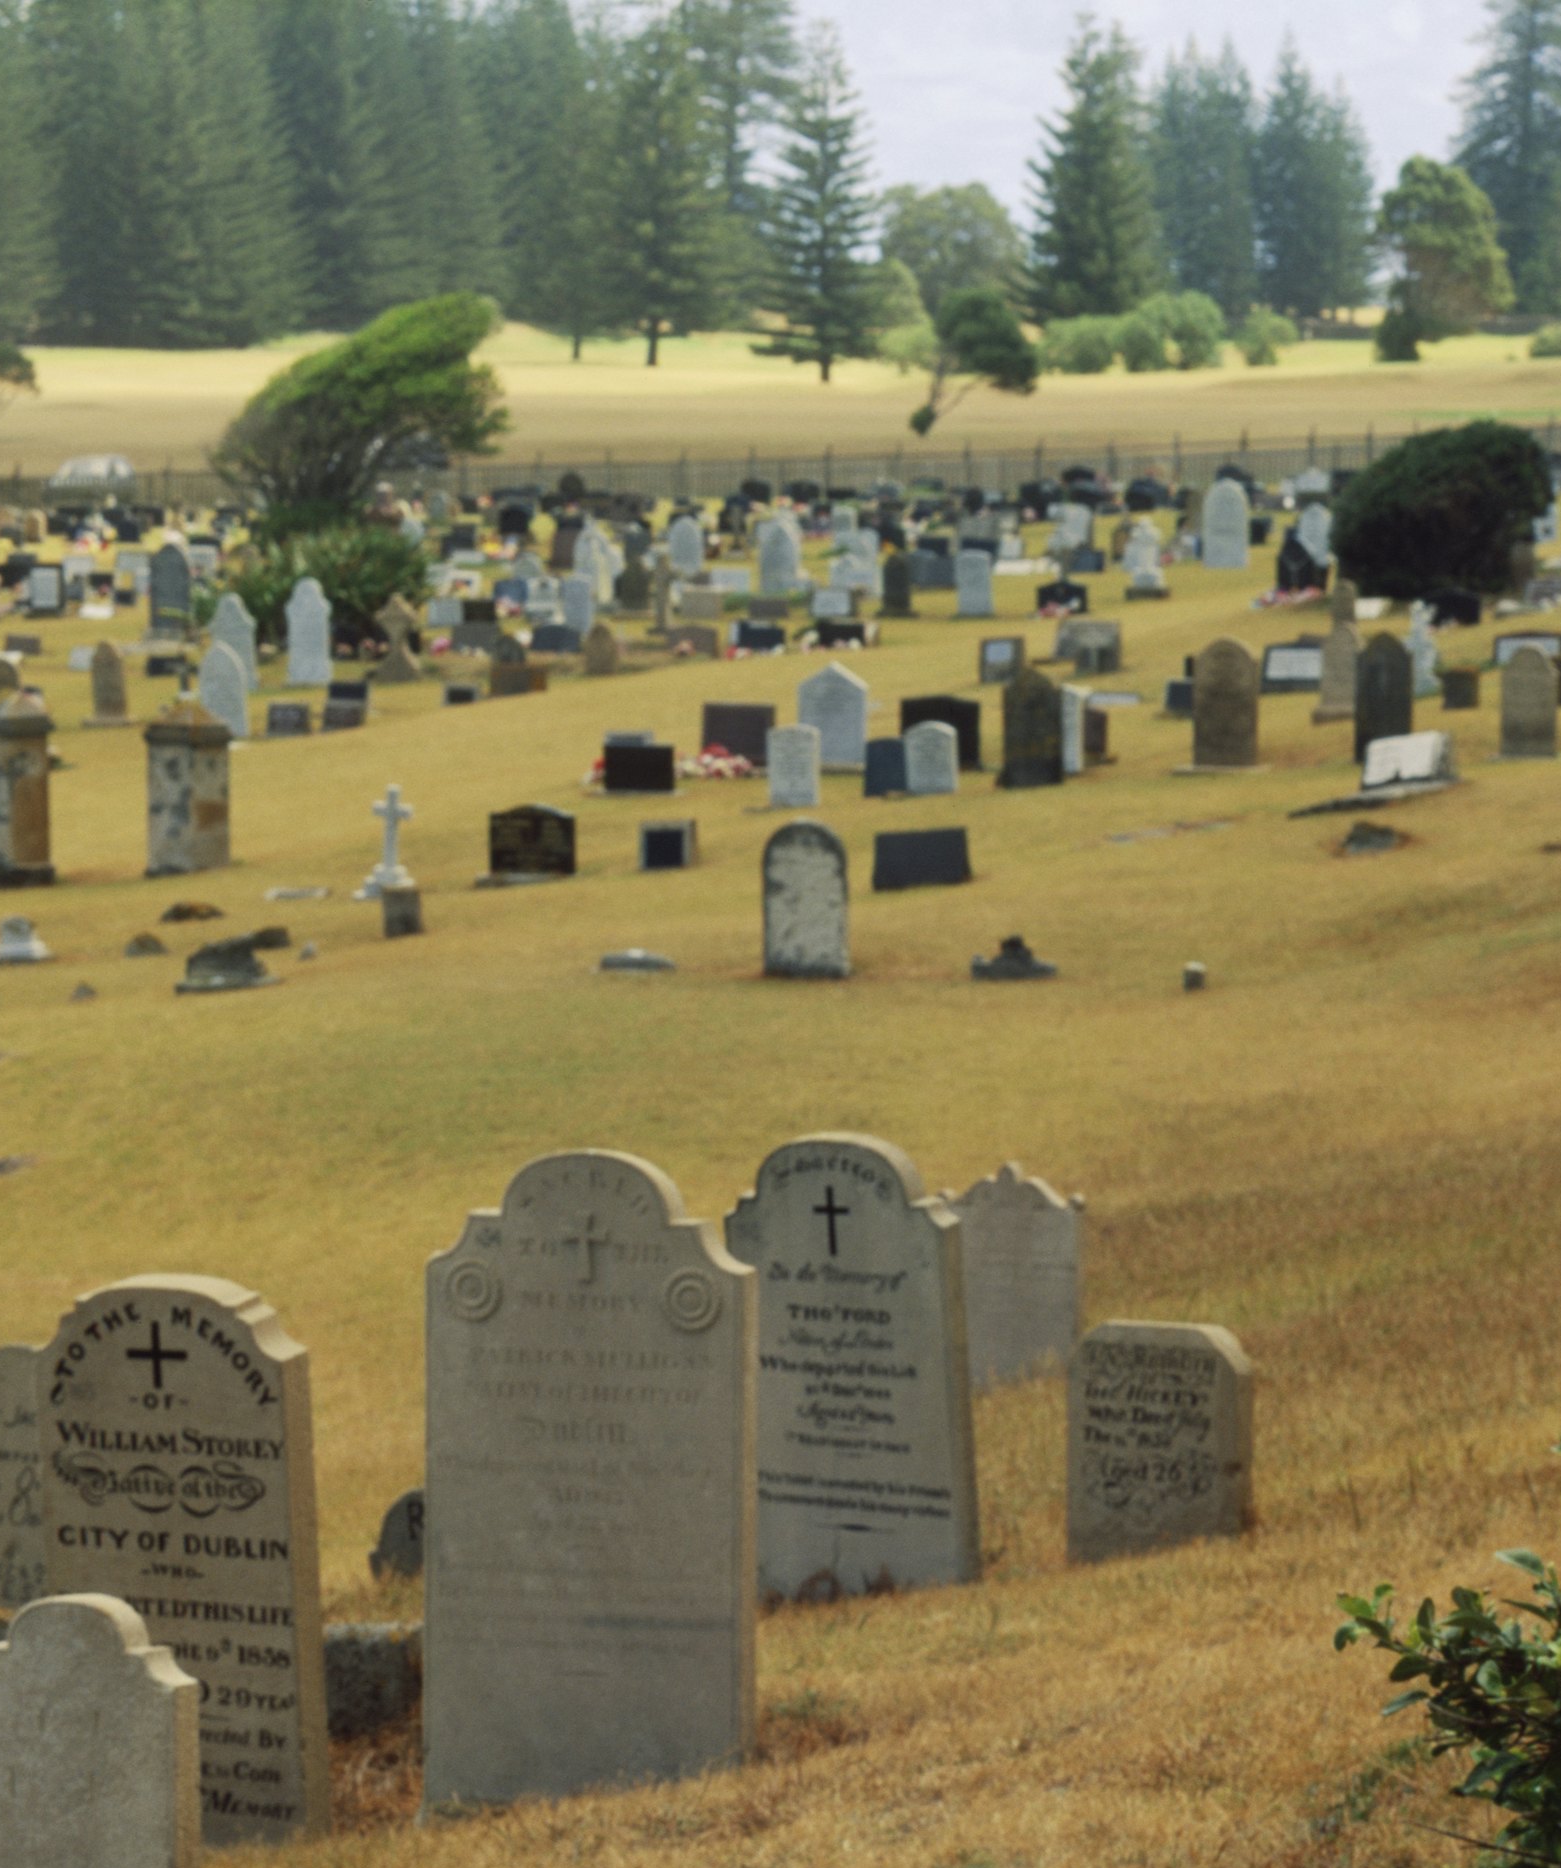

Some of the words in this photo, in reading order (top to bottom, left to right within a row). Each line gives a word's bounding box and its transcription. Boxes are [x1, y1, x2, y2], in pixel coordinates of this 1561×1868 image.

[54, 1341, 85, 1378] TO
[84, 1301, 141, 1343] THE
[170, 1305, 278, 1408] MEMORY
[56, 1420, 178, 1455] WILLIAM
[180, 1427, 284, 1460] STOREY
[57, 1524, 130, 1551] CITY
[137, 1531, 171, 1553] OF
[183, 1533, 290, 1560] DUBLIN
[189, 1602, 246, 1624] THIS
[247, 1605, 294, 1628] LIFE
